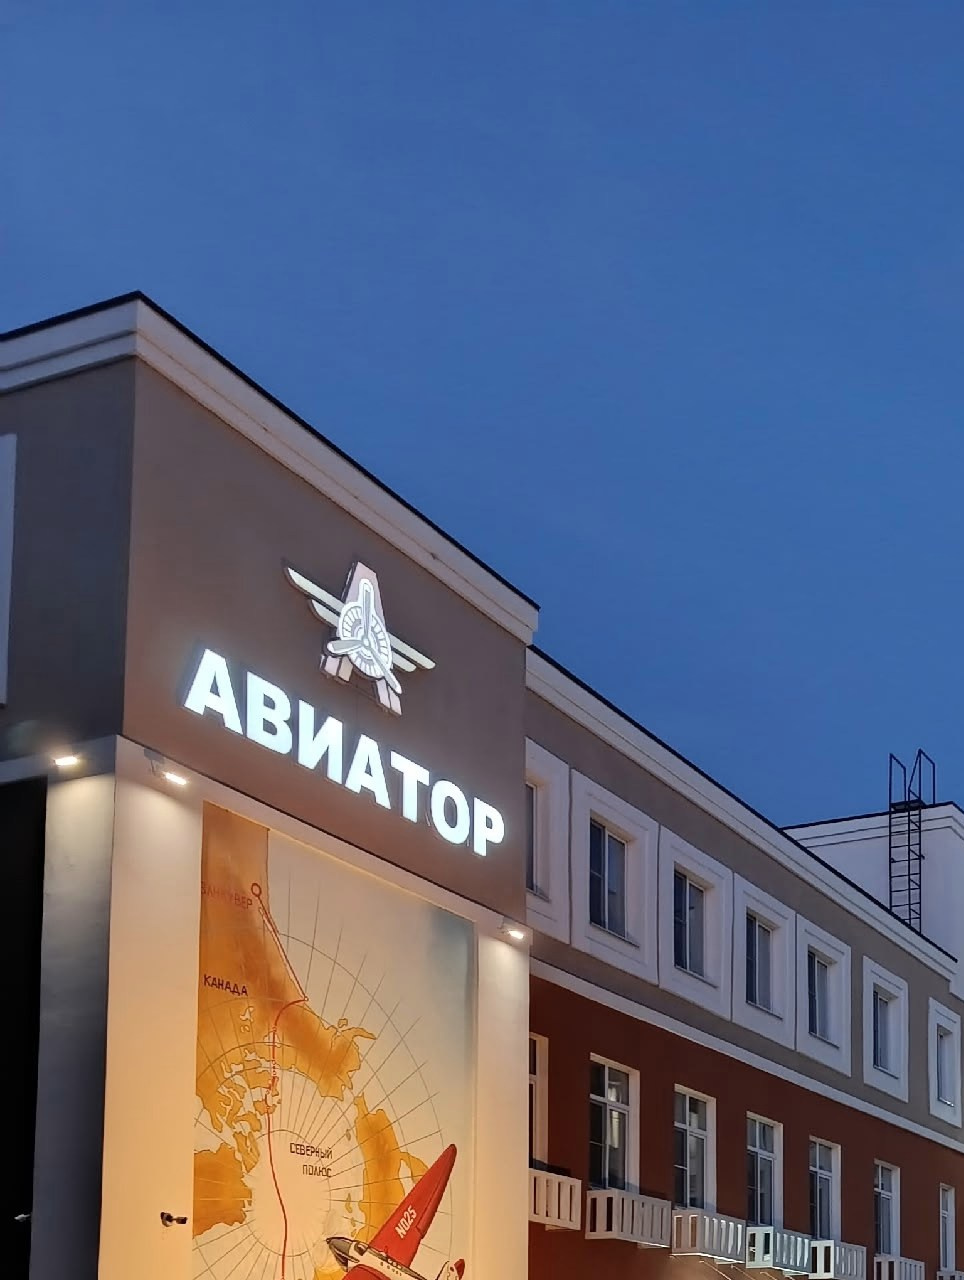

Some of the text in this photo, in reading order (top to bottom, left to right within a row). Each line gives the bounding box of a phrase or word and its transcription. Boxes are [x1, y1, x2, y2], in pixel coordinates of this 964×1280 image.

[183, 648, 505, 857] АВИАТОР
[203, 974, 248, 997] КАНАДА
[290, 1143, 332, 1159] СЕВЕРНЫЙ
[303, 1165, 331, 1177] ПОЛЮС
